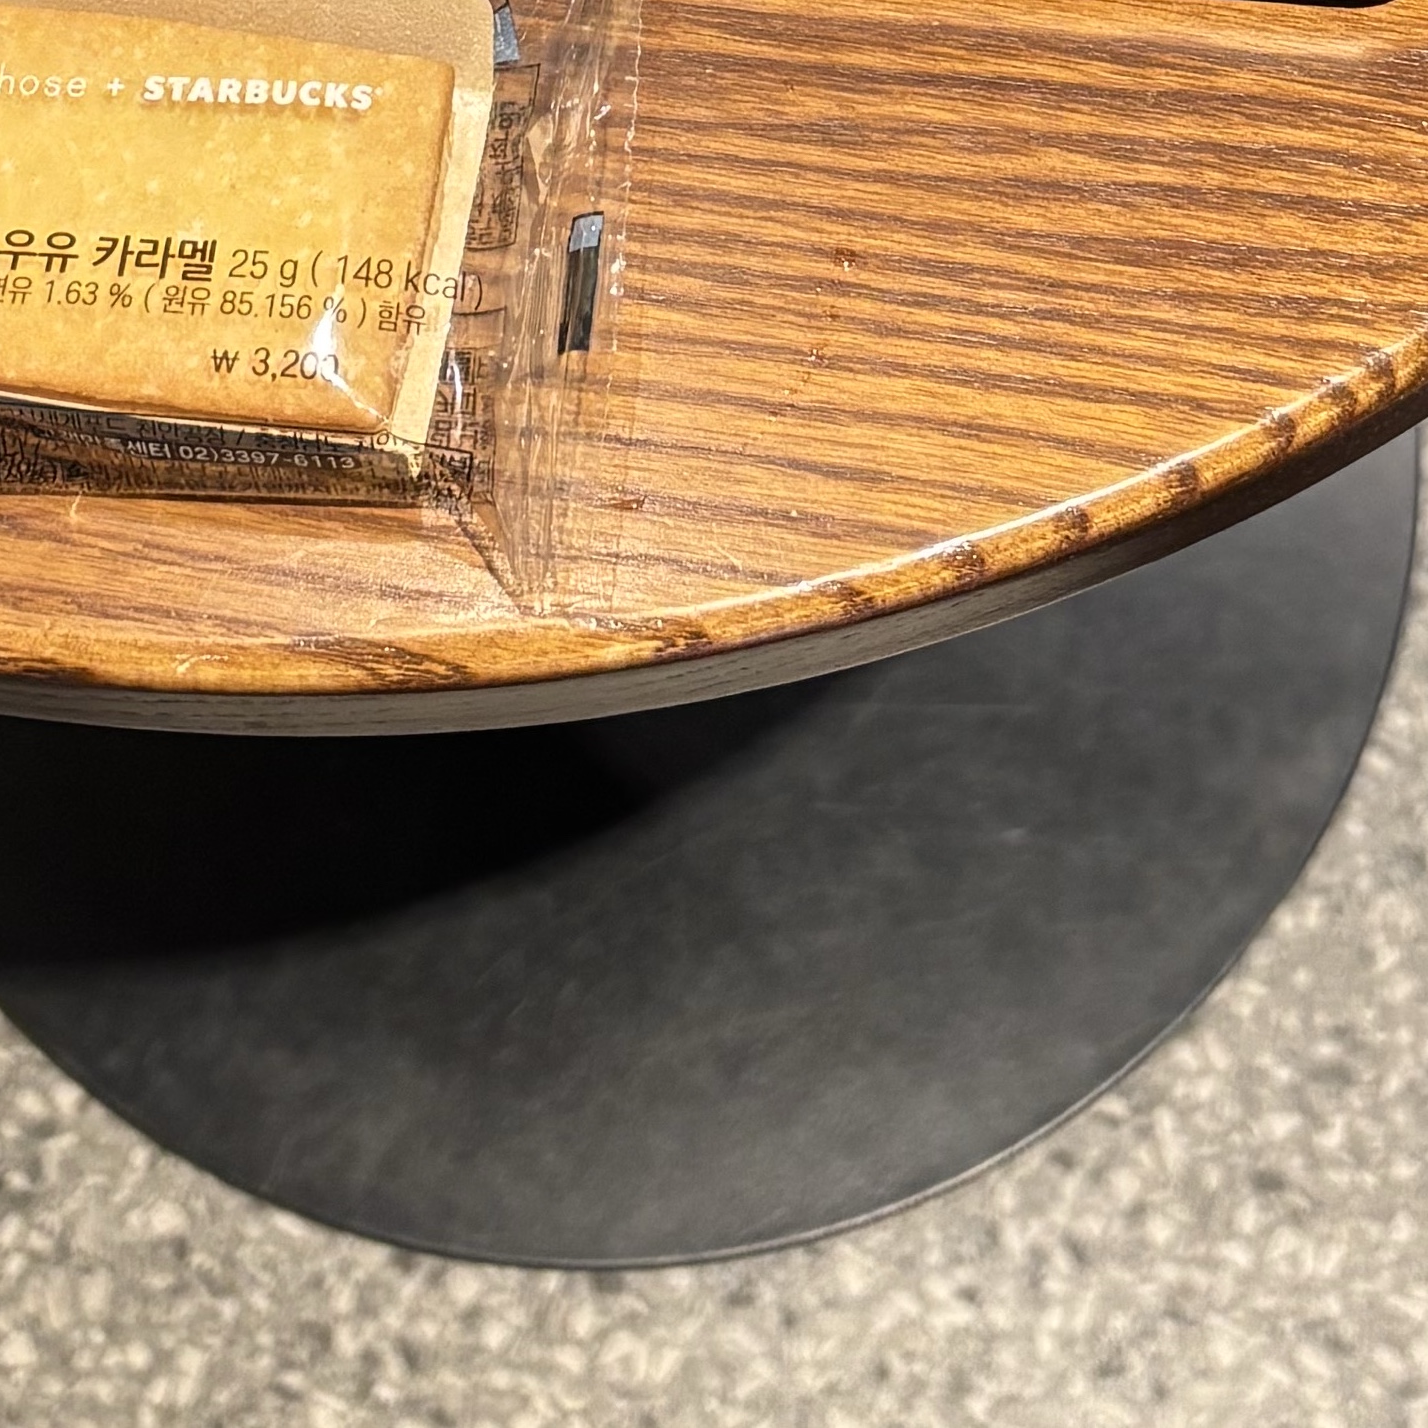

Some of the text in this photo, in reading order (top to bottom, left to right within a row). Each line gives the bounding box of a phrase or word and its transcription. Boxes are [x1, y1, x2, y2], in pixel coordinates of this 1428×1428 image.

[143, 75, 373, 111] STARBUCKS
[92, 235, 218, 282] 카라멜
[228, 249, 269, 280] 25
[279, 258, 299, 288] g
[337, 255, 394, 289] 148
[45, 279, 99, 306] 1.63
[109, 282, 133, 309] %
[161, 284, 211, 317] 원유
[219, 289, 313, 320] 85.156
[323, 296, 347, 324] %
[378, 300, 427, 335] 함유
[178, 446, 356, 469] 02)3397-6113
